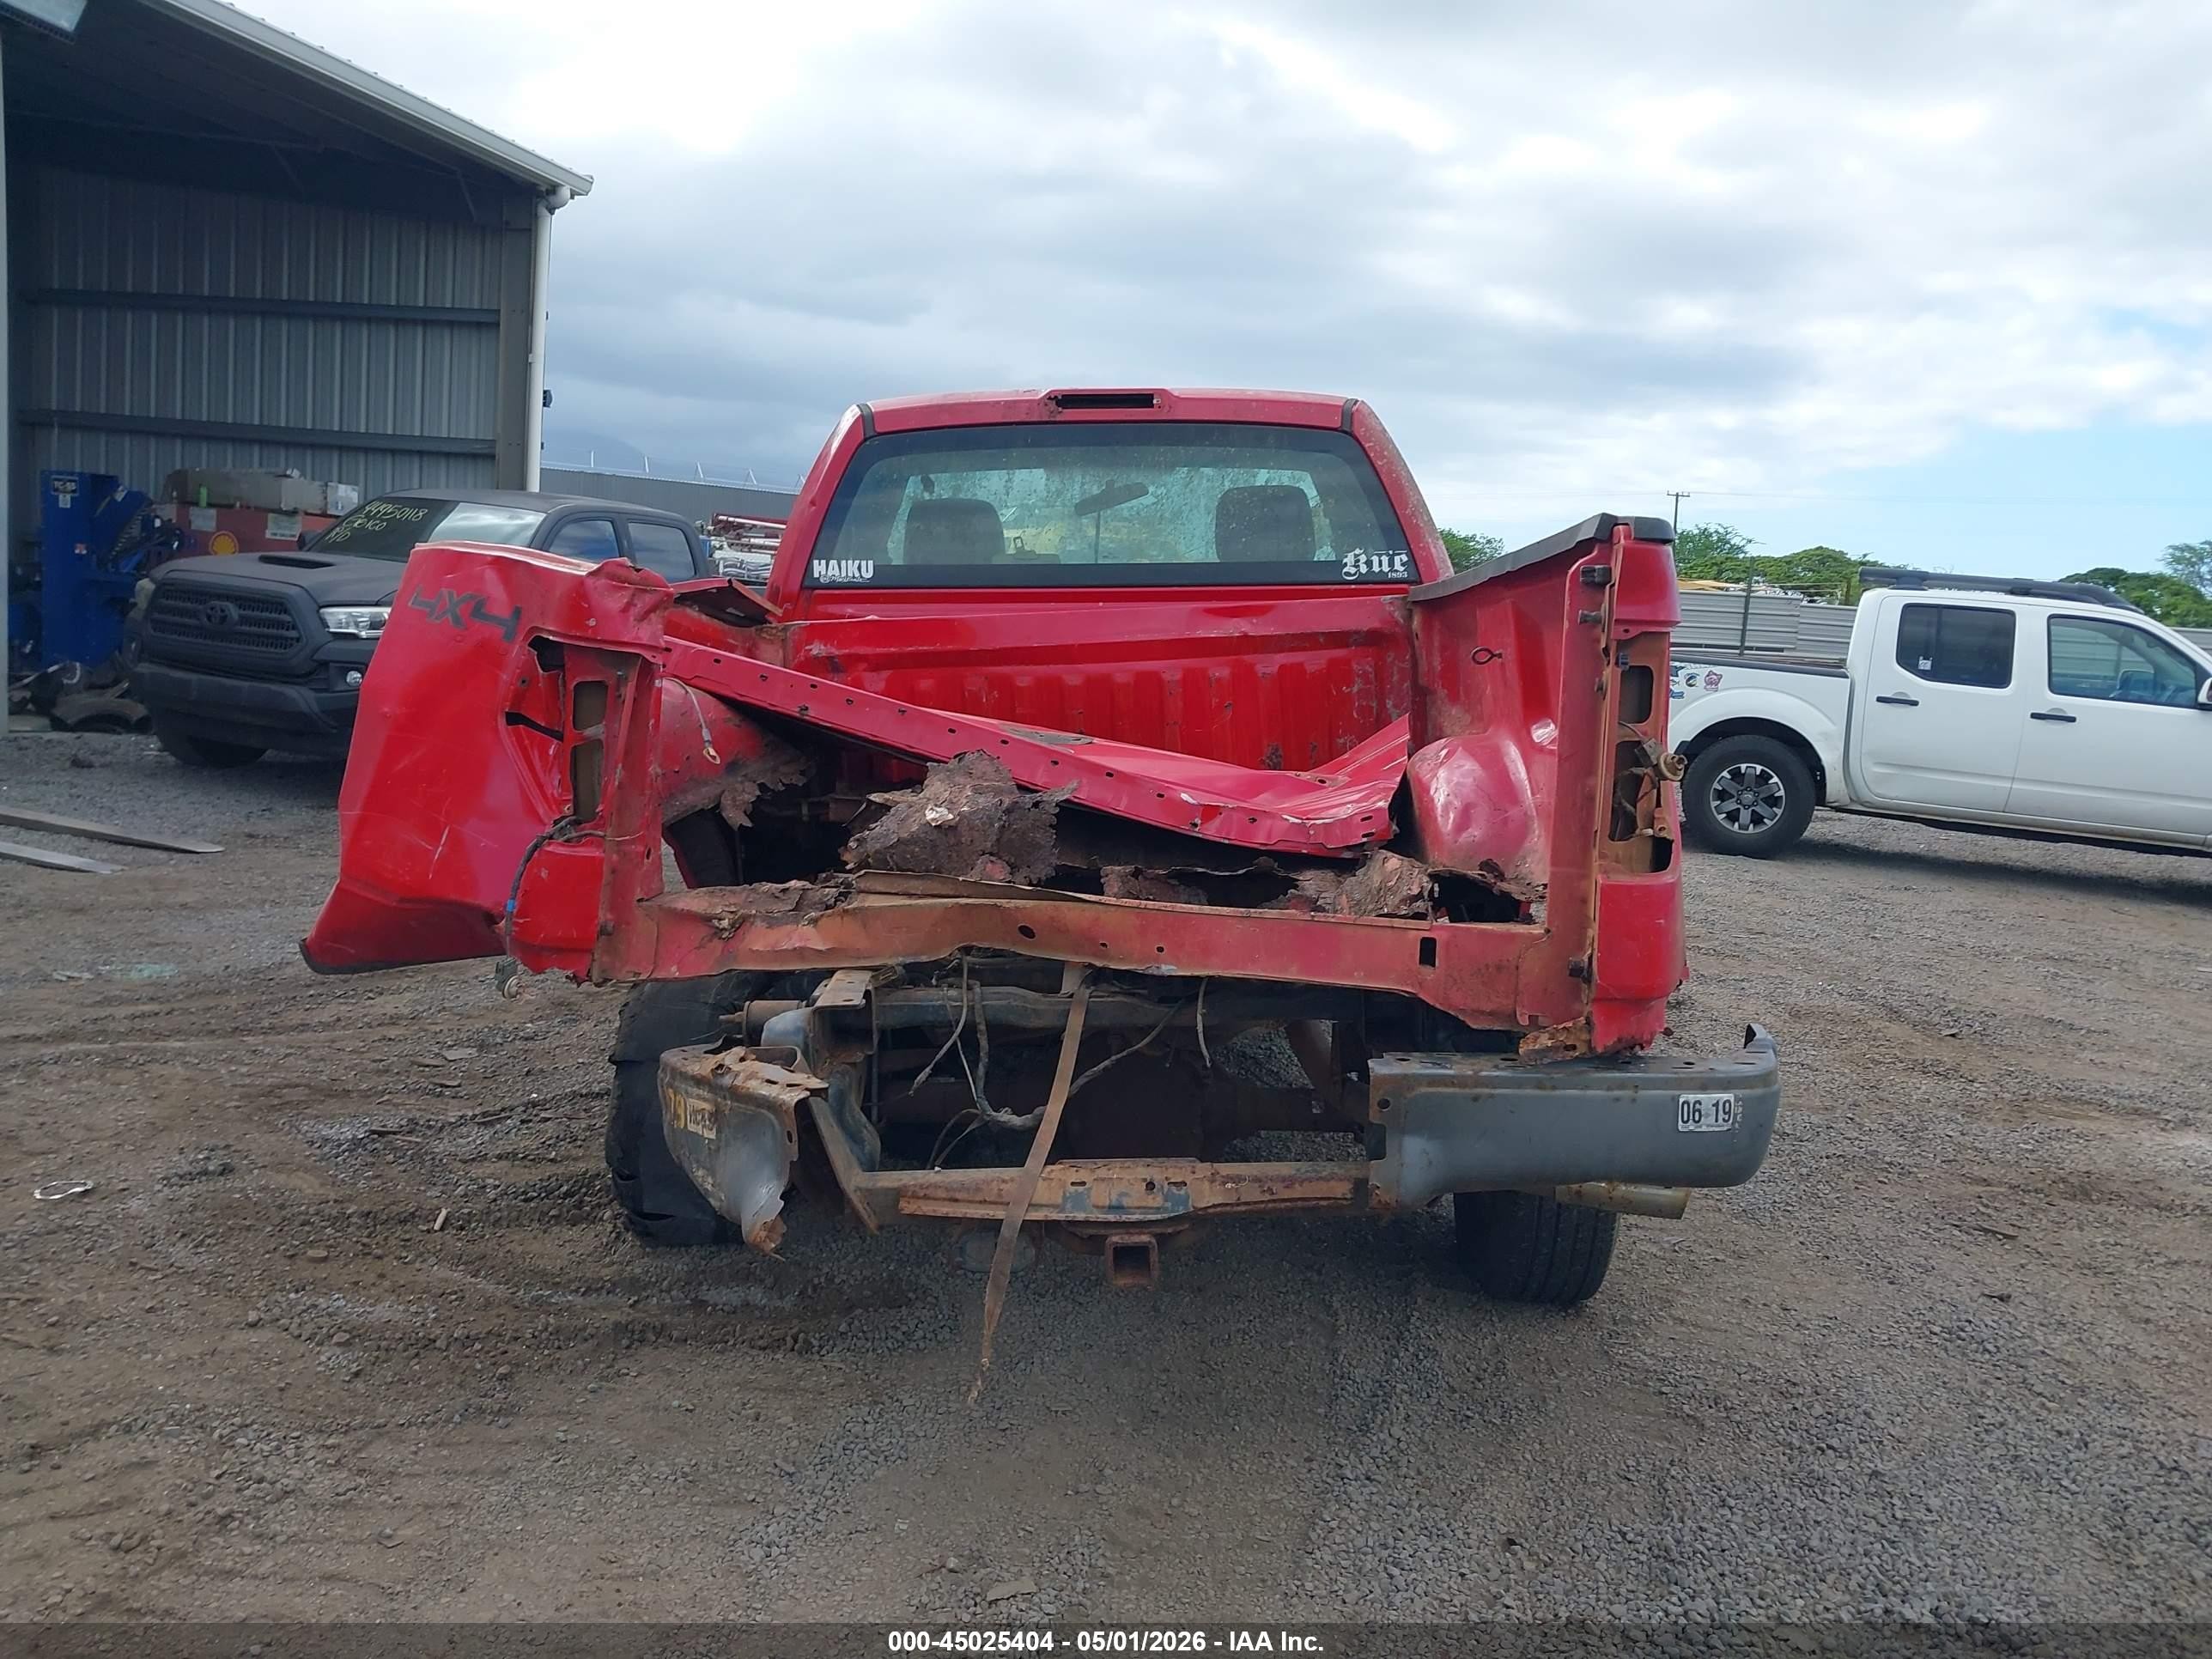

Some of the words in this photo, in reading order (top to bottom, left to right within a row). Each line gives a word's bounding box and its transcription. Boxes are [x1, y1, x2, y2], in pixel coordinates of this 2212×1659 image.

[812, 559, 874, 578] HAIKU
[1680, 1099, 1703, 1124] 06
[1711, 1098, 1733, 1123] 19
